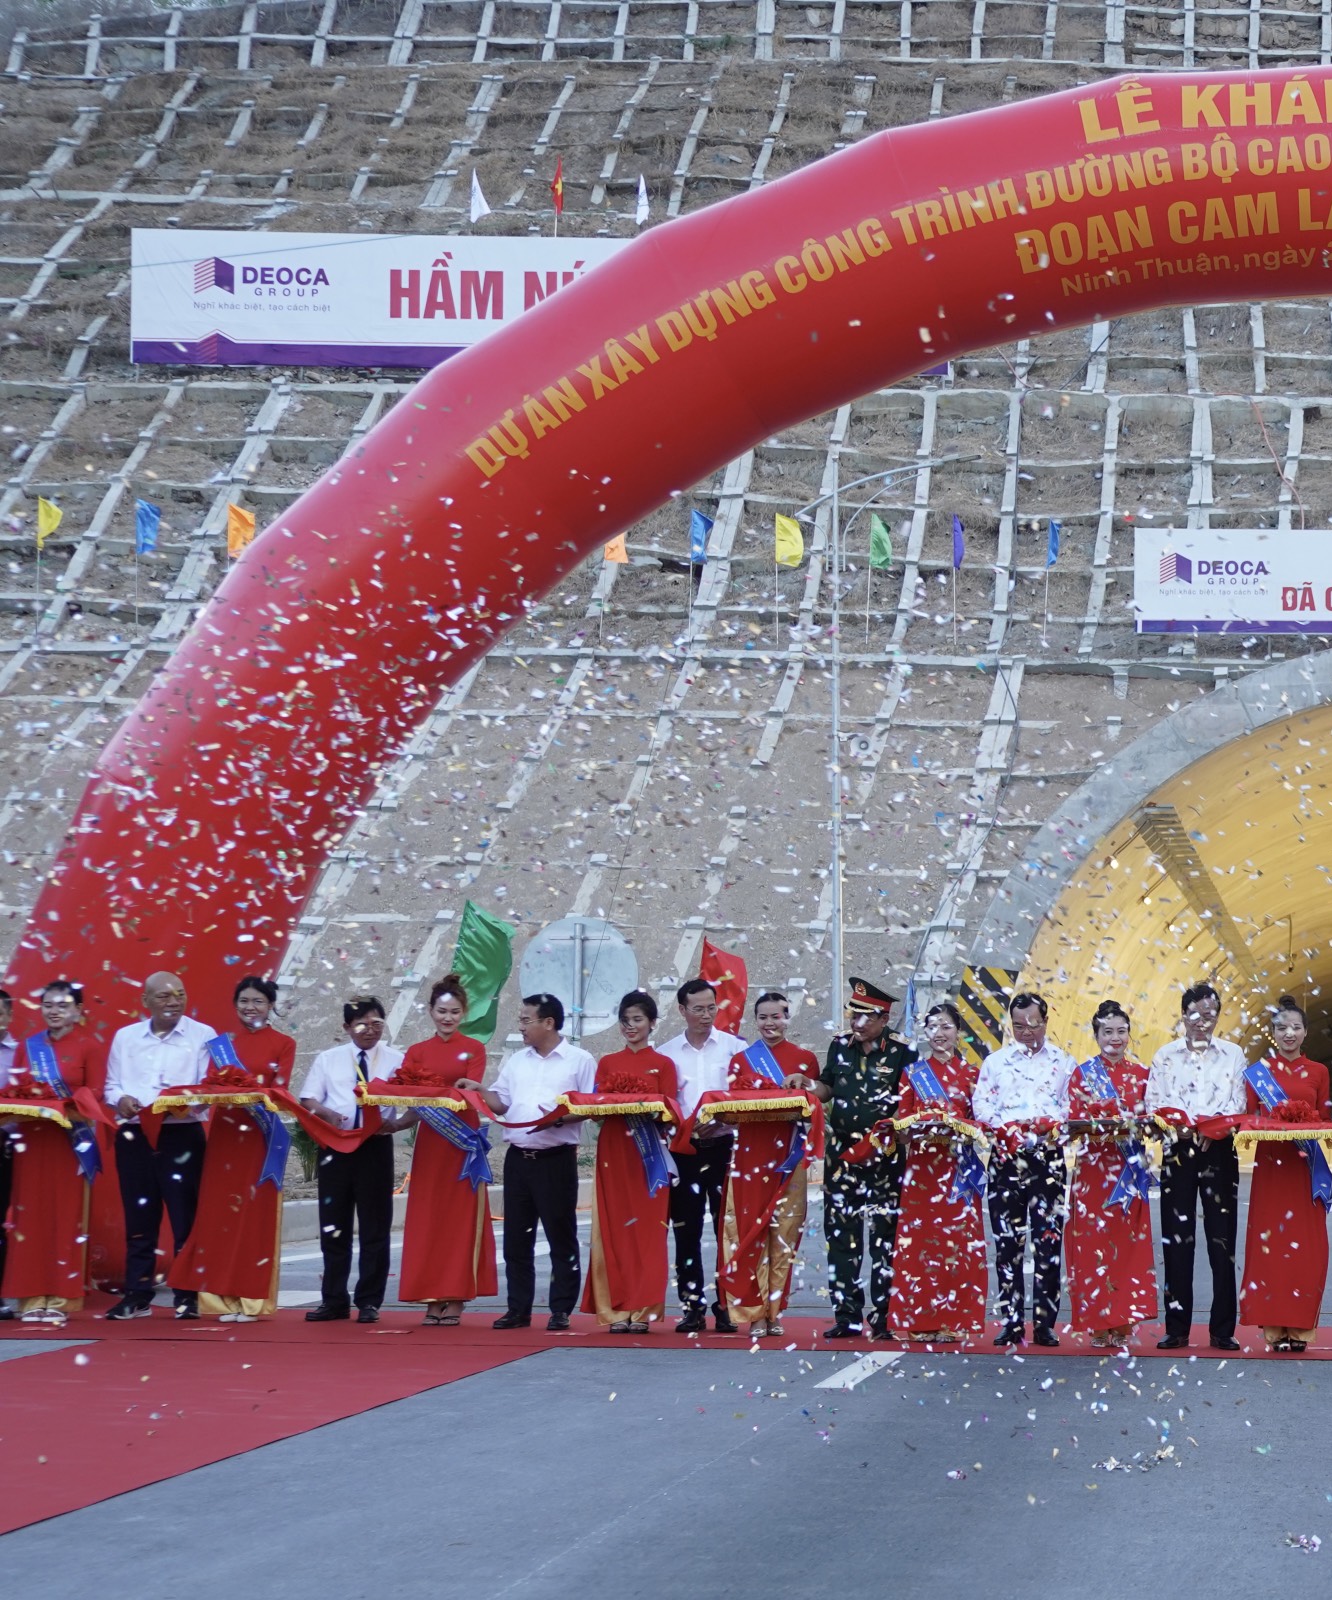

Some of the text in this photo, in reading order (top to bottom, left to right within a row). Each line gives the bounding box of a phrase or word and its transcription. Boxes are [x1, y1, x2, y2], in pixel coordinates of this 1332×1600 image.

[1079, 76, 1161, 144] LỄ
[1014, 206, 1154, 274] ĐOẠN
[1167, 191, 1280, 244] CAM
[242, 266, 330, 286] DEOCA
[390, 251, 504, 320] HẦM
[1061, 267, 1132, 297] Ninh
[1244, 244, 1316, 271] ngày
[254, 287, 319, 297] GROUP
[464, 408, 531, 479] DỰ
[522, 376, 587, 439] ÁN
[575, 324, 660, 400] XÂY
[655, 270, 777, 352] DỰNG
[774, 217, 893, 294] CÔNG
[891, 178, 1019, 245] TRÌNH
[1025, 147, 1173, 209] ĐƯỜNG
[1181, 132, 1238, 184] BỘ
[1247, 133, 1332, 176] CAO
[218, 302, 241, 310] khác
[287, 304, 310, 312] cách
[313, 304, 331, 313] biệt
[1198, 560, 1269, 576] DEOCA
[1207, 578, 1259, 586] GROUP
[1281, 581, 1317, 611] ĐÃ
